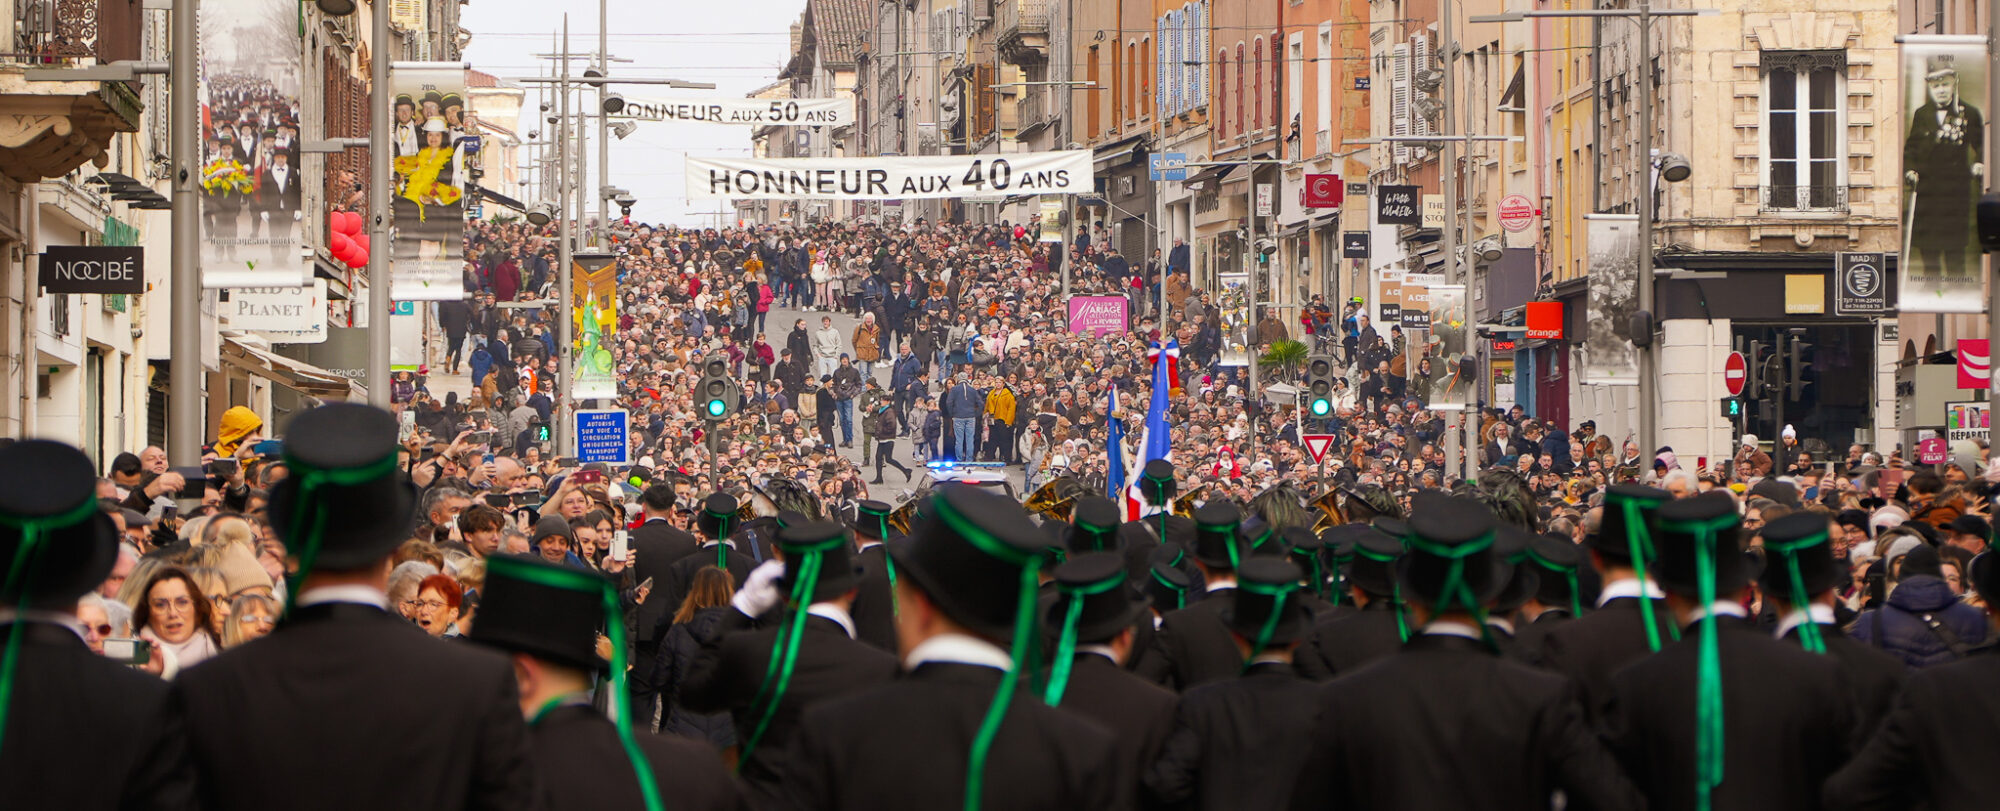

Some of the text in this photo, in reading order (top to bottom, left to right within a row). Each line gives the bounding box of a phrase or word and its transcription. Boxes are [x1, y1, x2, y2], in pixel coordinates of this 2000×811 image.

[619, 101, 837, 122] ONNEUR AUX 50 ANS
[709, 158, 1070, 195] HONNEUR AUX 40 ANS
[55, 256, 134, 280] NOCIBÉ
[237, 300, 304, 316] PLANET
[1528, 330, 1560, 338] orange
[582, 434, 621, 442] CIRCULATION
